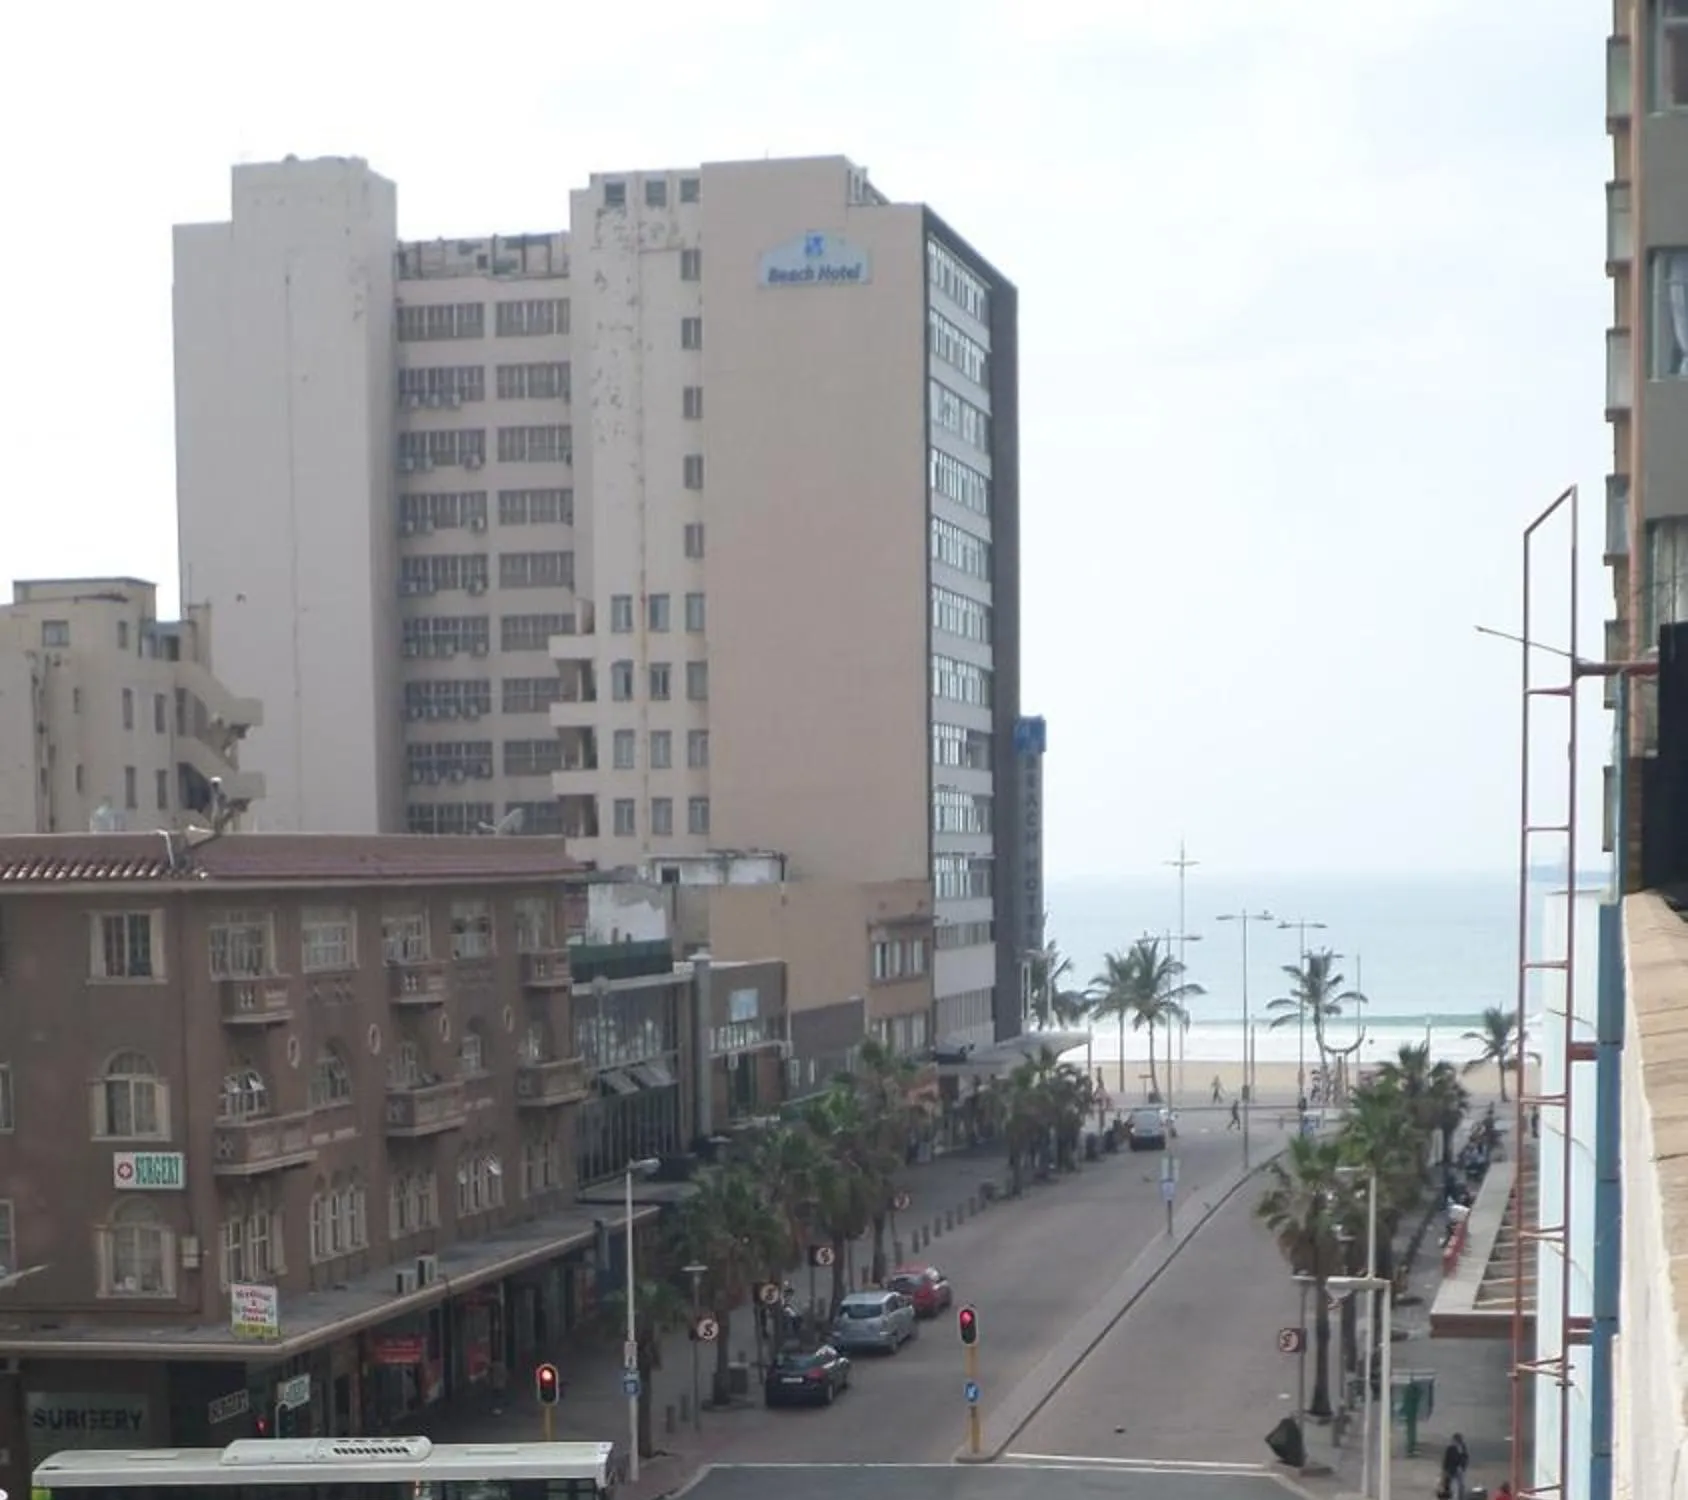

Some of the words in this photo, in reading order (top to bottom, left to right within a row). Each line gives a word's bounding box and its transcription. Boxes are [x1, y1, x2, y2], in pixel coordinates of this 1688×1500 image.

[768, 265, 814, 283] Beach
[818, 262, 862, 281] Hotel
[135, 1155, 180, 1185] SURGERY
[33, 1407, 144, 1432] SURGERY
